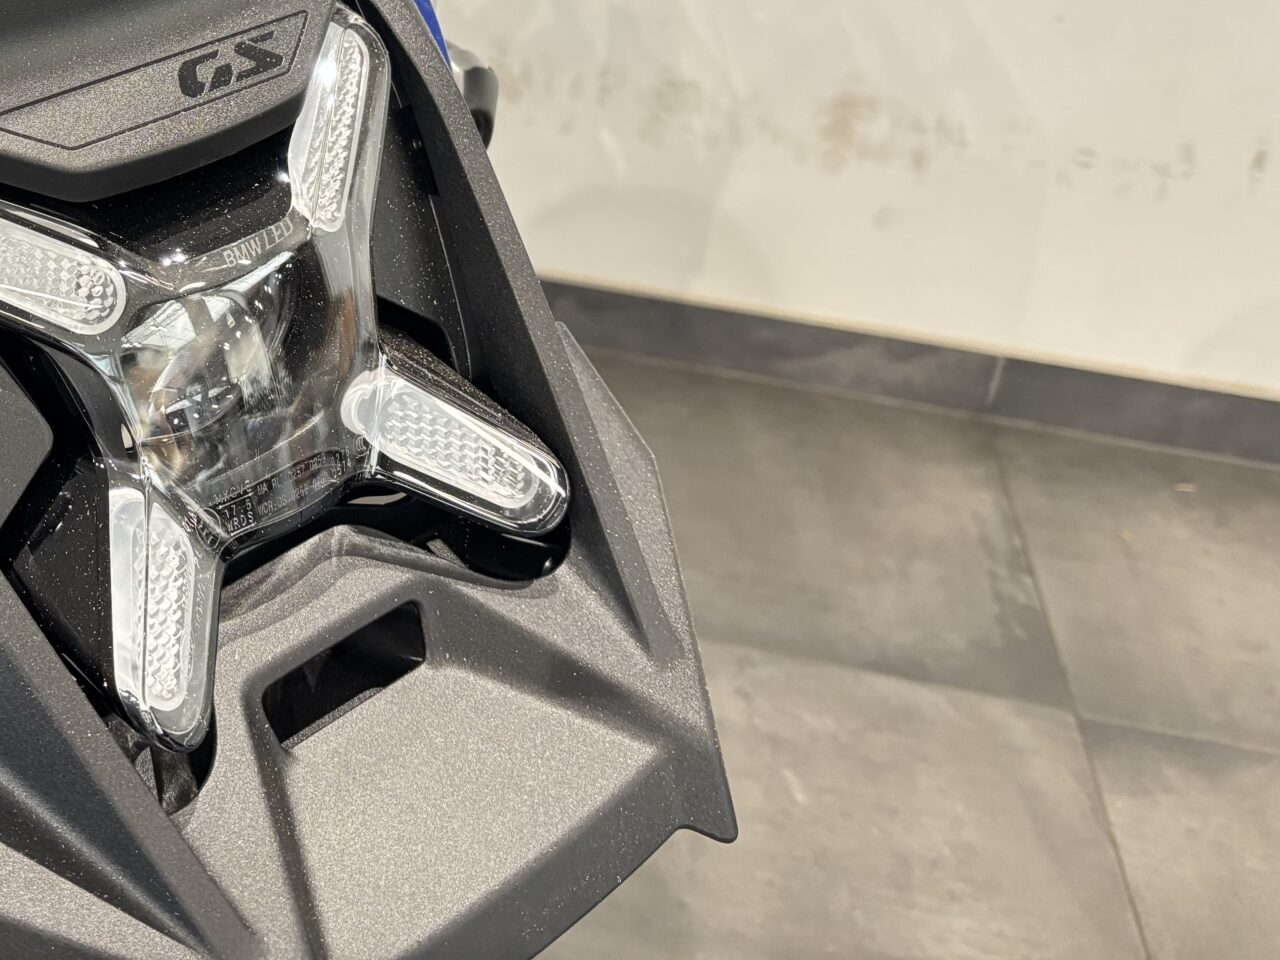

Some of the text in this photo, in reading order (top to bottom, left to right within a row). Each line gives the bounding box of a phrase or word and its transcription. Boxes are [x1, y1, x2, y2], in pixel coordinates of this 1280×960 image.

[178, 30, 284, 98] GS
[223, 217, 293, 267] BMW LED
